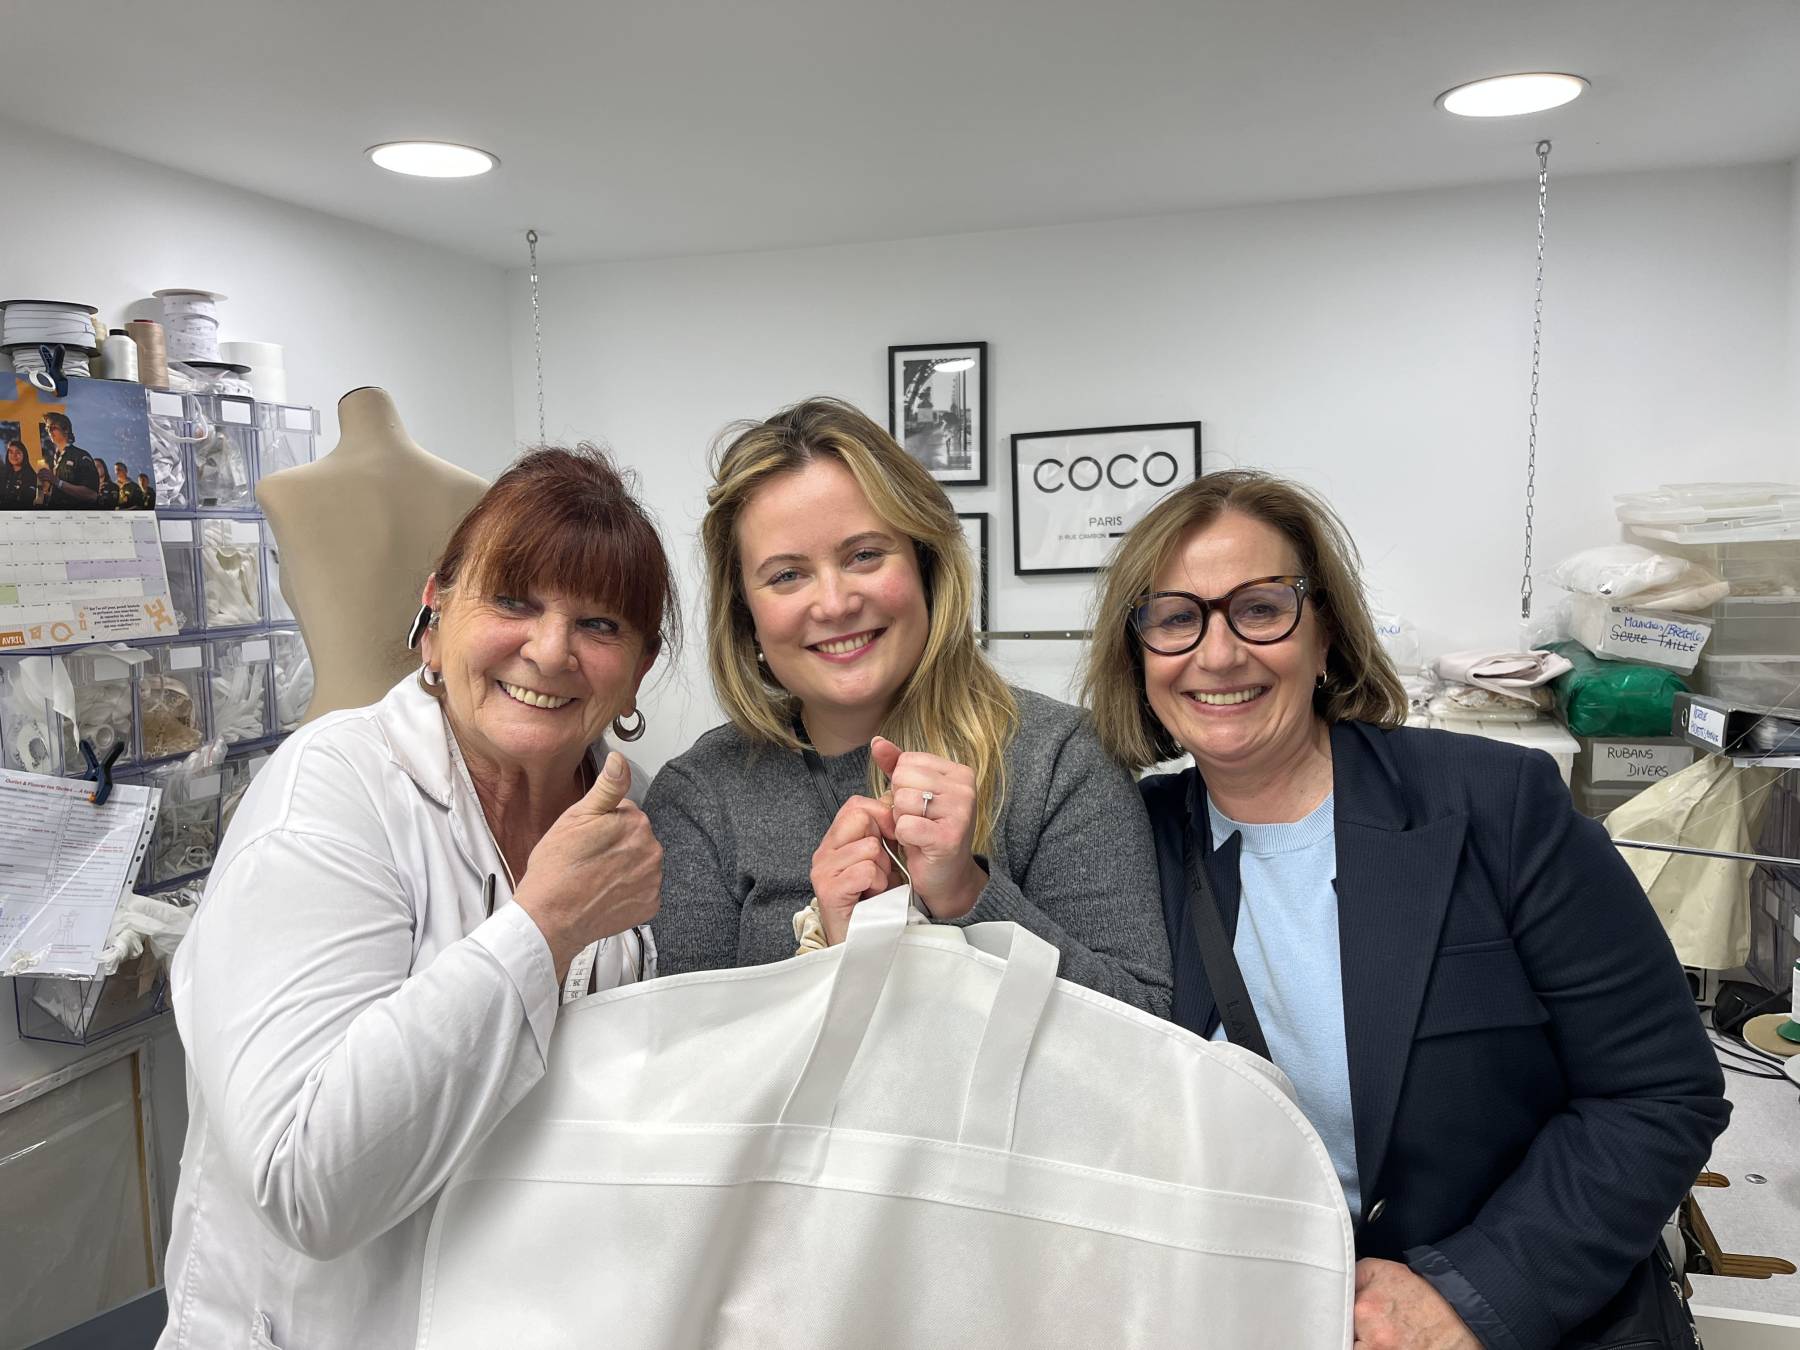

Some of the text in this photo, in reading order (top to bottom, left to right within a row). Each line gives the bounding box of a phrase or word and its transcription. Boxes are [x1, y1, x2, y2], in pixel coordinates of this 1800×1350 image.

[1033, 451, 1179, 494] COCO
[1088, 516, 1123, 527] PARIS
[2, 635, 24, 645] AVRIL
[1607, 746, 1654, 759] RUBANS
